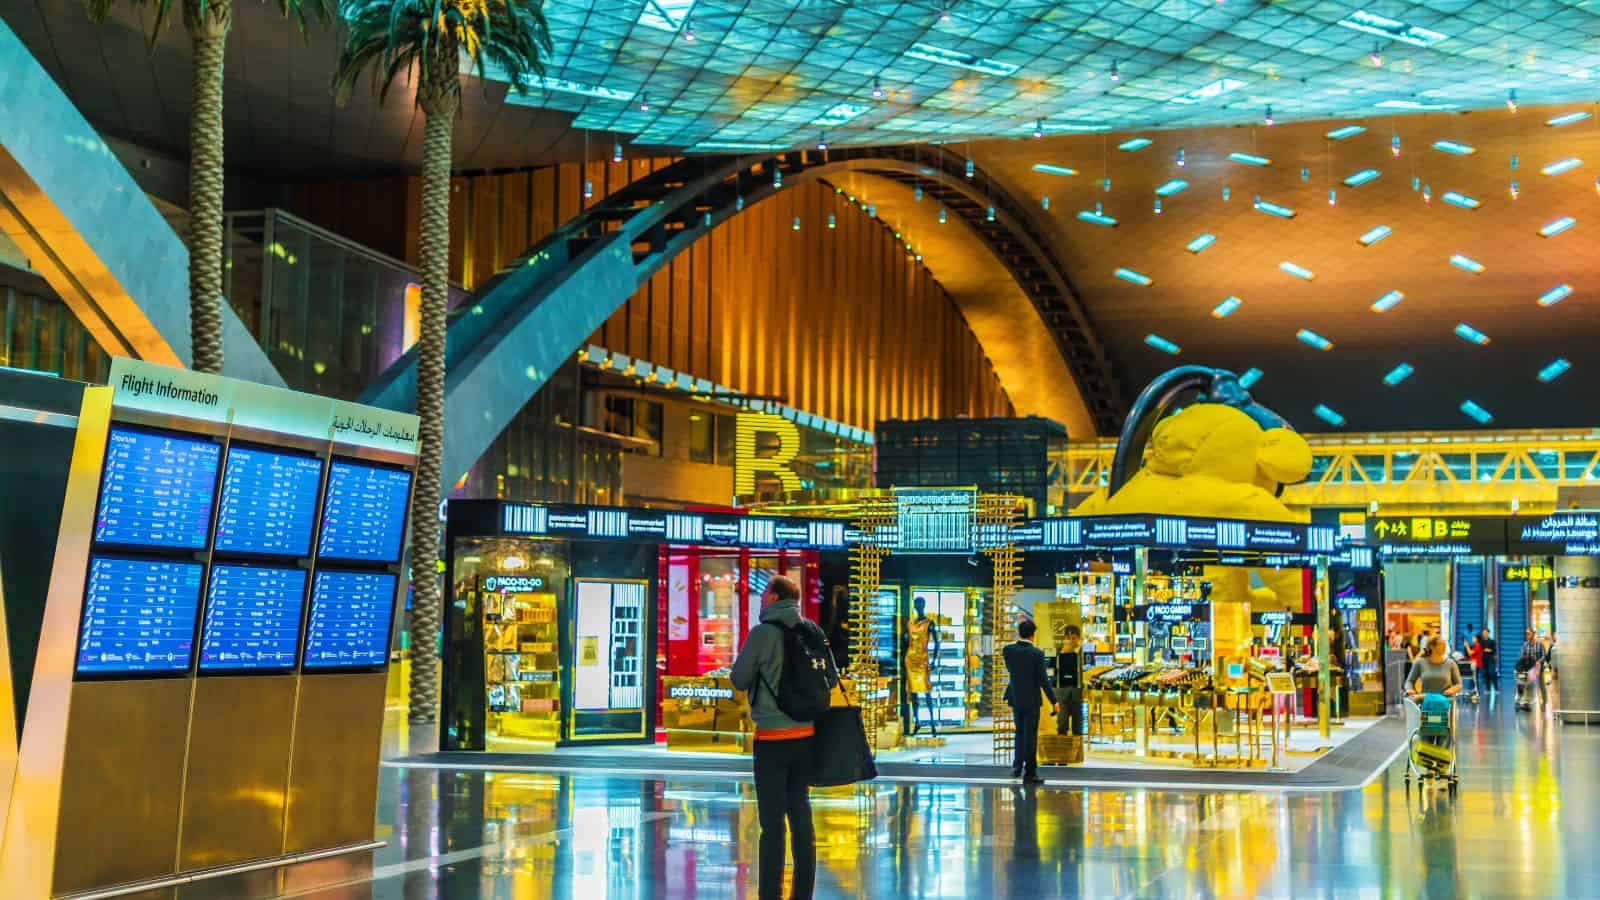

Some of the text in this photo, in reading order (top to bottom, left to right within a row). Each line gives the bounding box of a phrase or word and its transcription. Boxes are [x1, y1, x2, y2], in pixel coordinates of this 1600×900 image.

[121, 375, 218, 406] Flight Information
[736, 413, 802, 496] R
[1435, 520, 1448, 537] B
[671, 687, 693, 698] paco
